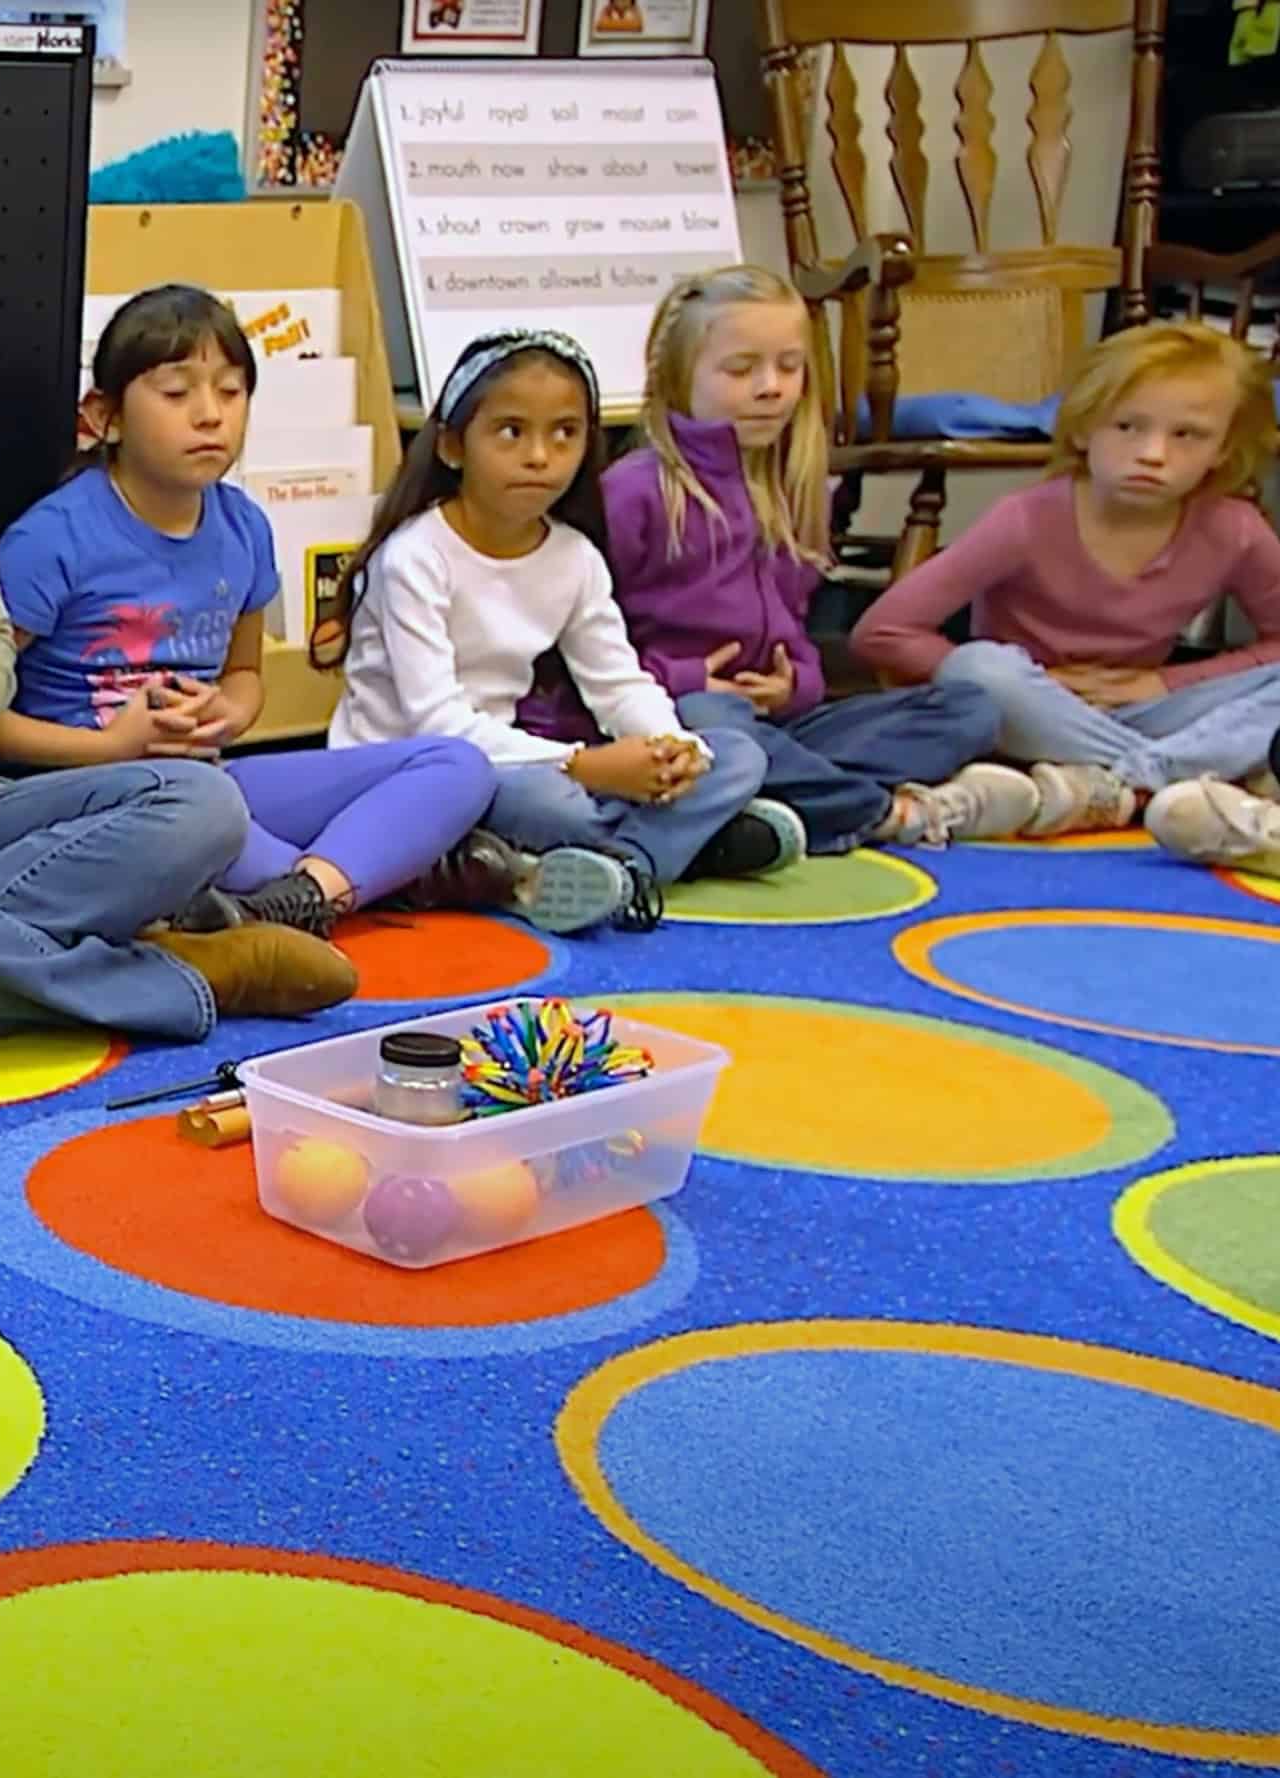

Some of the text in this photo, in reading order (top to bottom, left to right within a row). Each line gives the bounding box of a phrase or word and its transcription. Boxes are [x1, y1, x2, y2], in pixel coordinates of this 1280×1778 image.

[418, 99, 465, 126] joyful
[488, 102, 529, 127] royal
[552, 102, 579, 121] soil
[428, 157, 480, 178] mouth
[491, 162, 525, 177] now
[548, 156, 589, 177] show
[602, 156, 648, 177] about
[437, 213, 481, 236] shout
[499, 219, 550, 234] crown
[565, 218, 605, 239] grow
[620, 217, 671, 231] mouse
[682, 211, 719, 231] blow
[445, 271, 529, 291] downtown
[539, 268, 602, 289] allowed
[611, 267, 658, 287] follow
